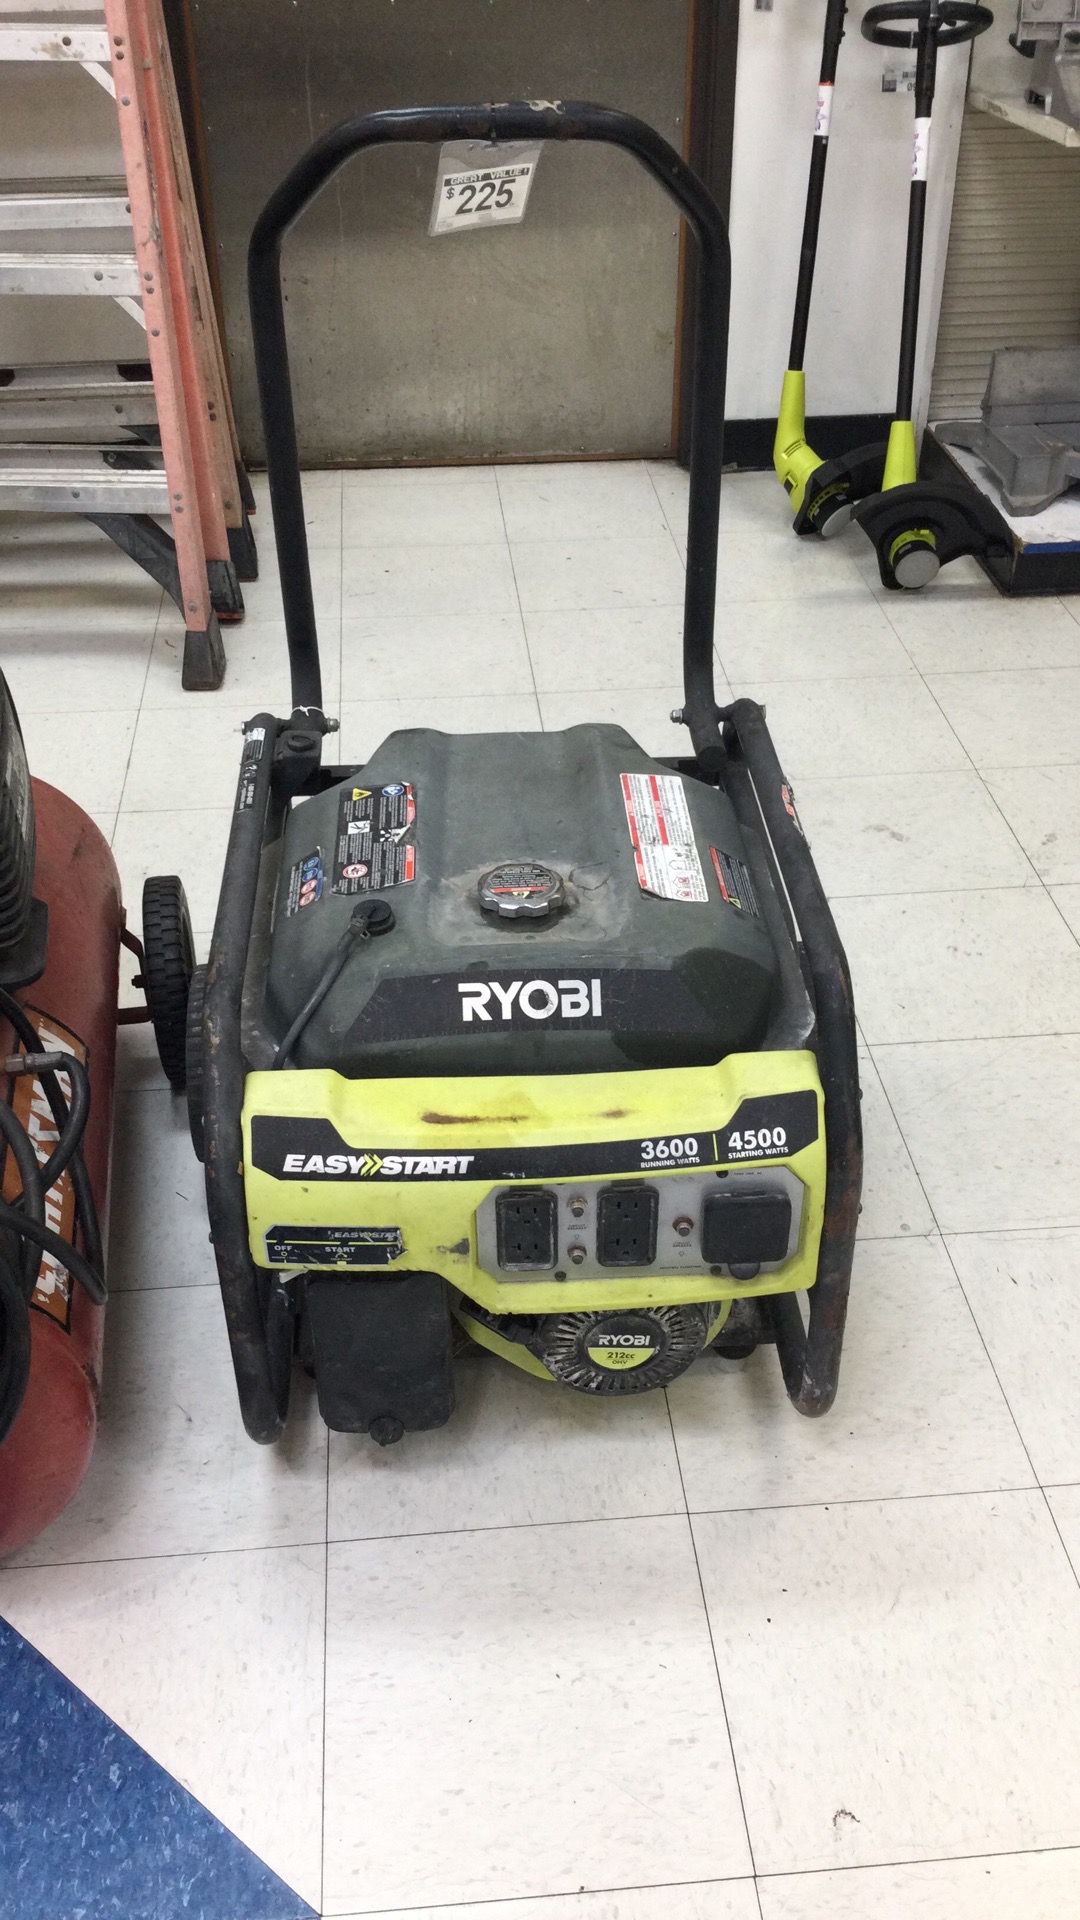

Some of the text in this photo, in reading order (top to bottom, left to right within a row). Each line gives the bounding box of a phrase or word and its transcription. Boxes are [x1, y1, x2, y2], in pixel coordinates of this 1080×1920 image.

[450, 173, 483, 185] GREAT
[457, 978, 602, 1022] RYOBI
[728, 1126, 787, 1151] 4500
[640, 1137, 699, 1160] 3600
[728, 1146, 789, 1160] STARTING WATTS
[640, 1156, 700, 1169] RUNNING WATTS
[598, 1334, 651, 1346] RYOBI
[607, 1351, 636, 1359] 212cc
